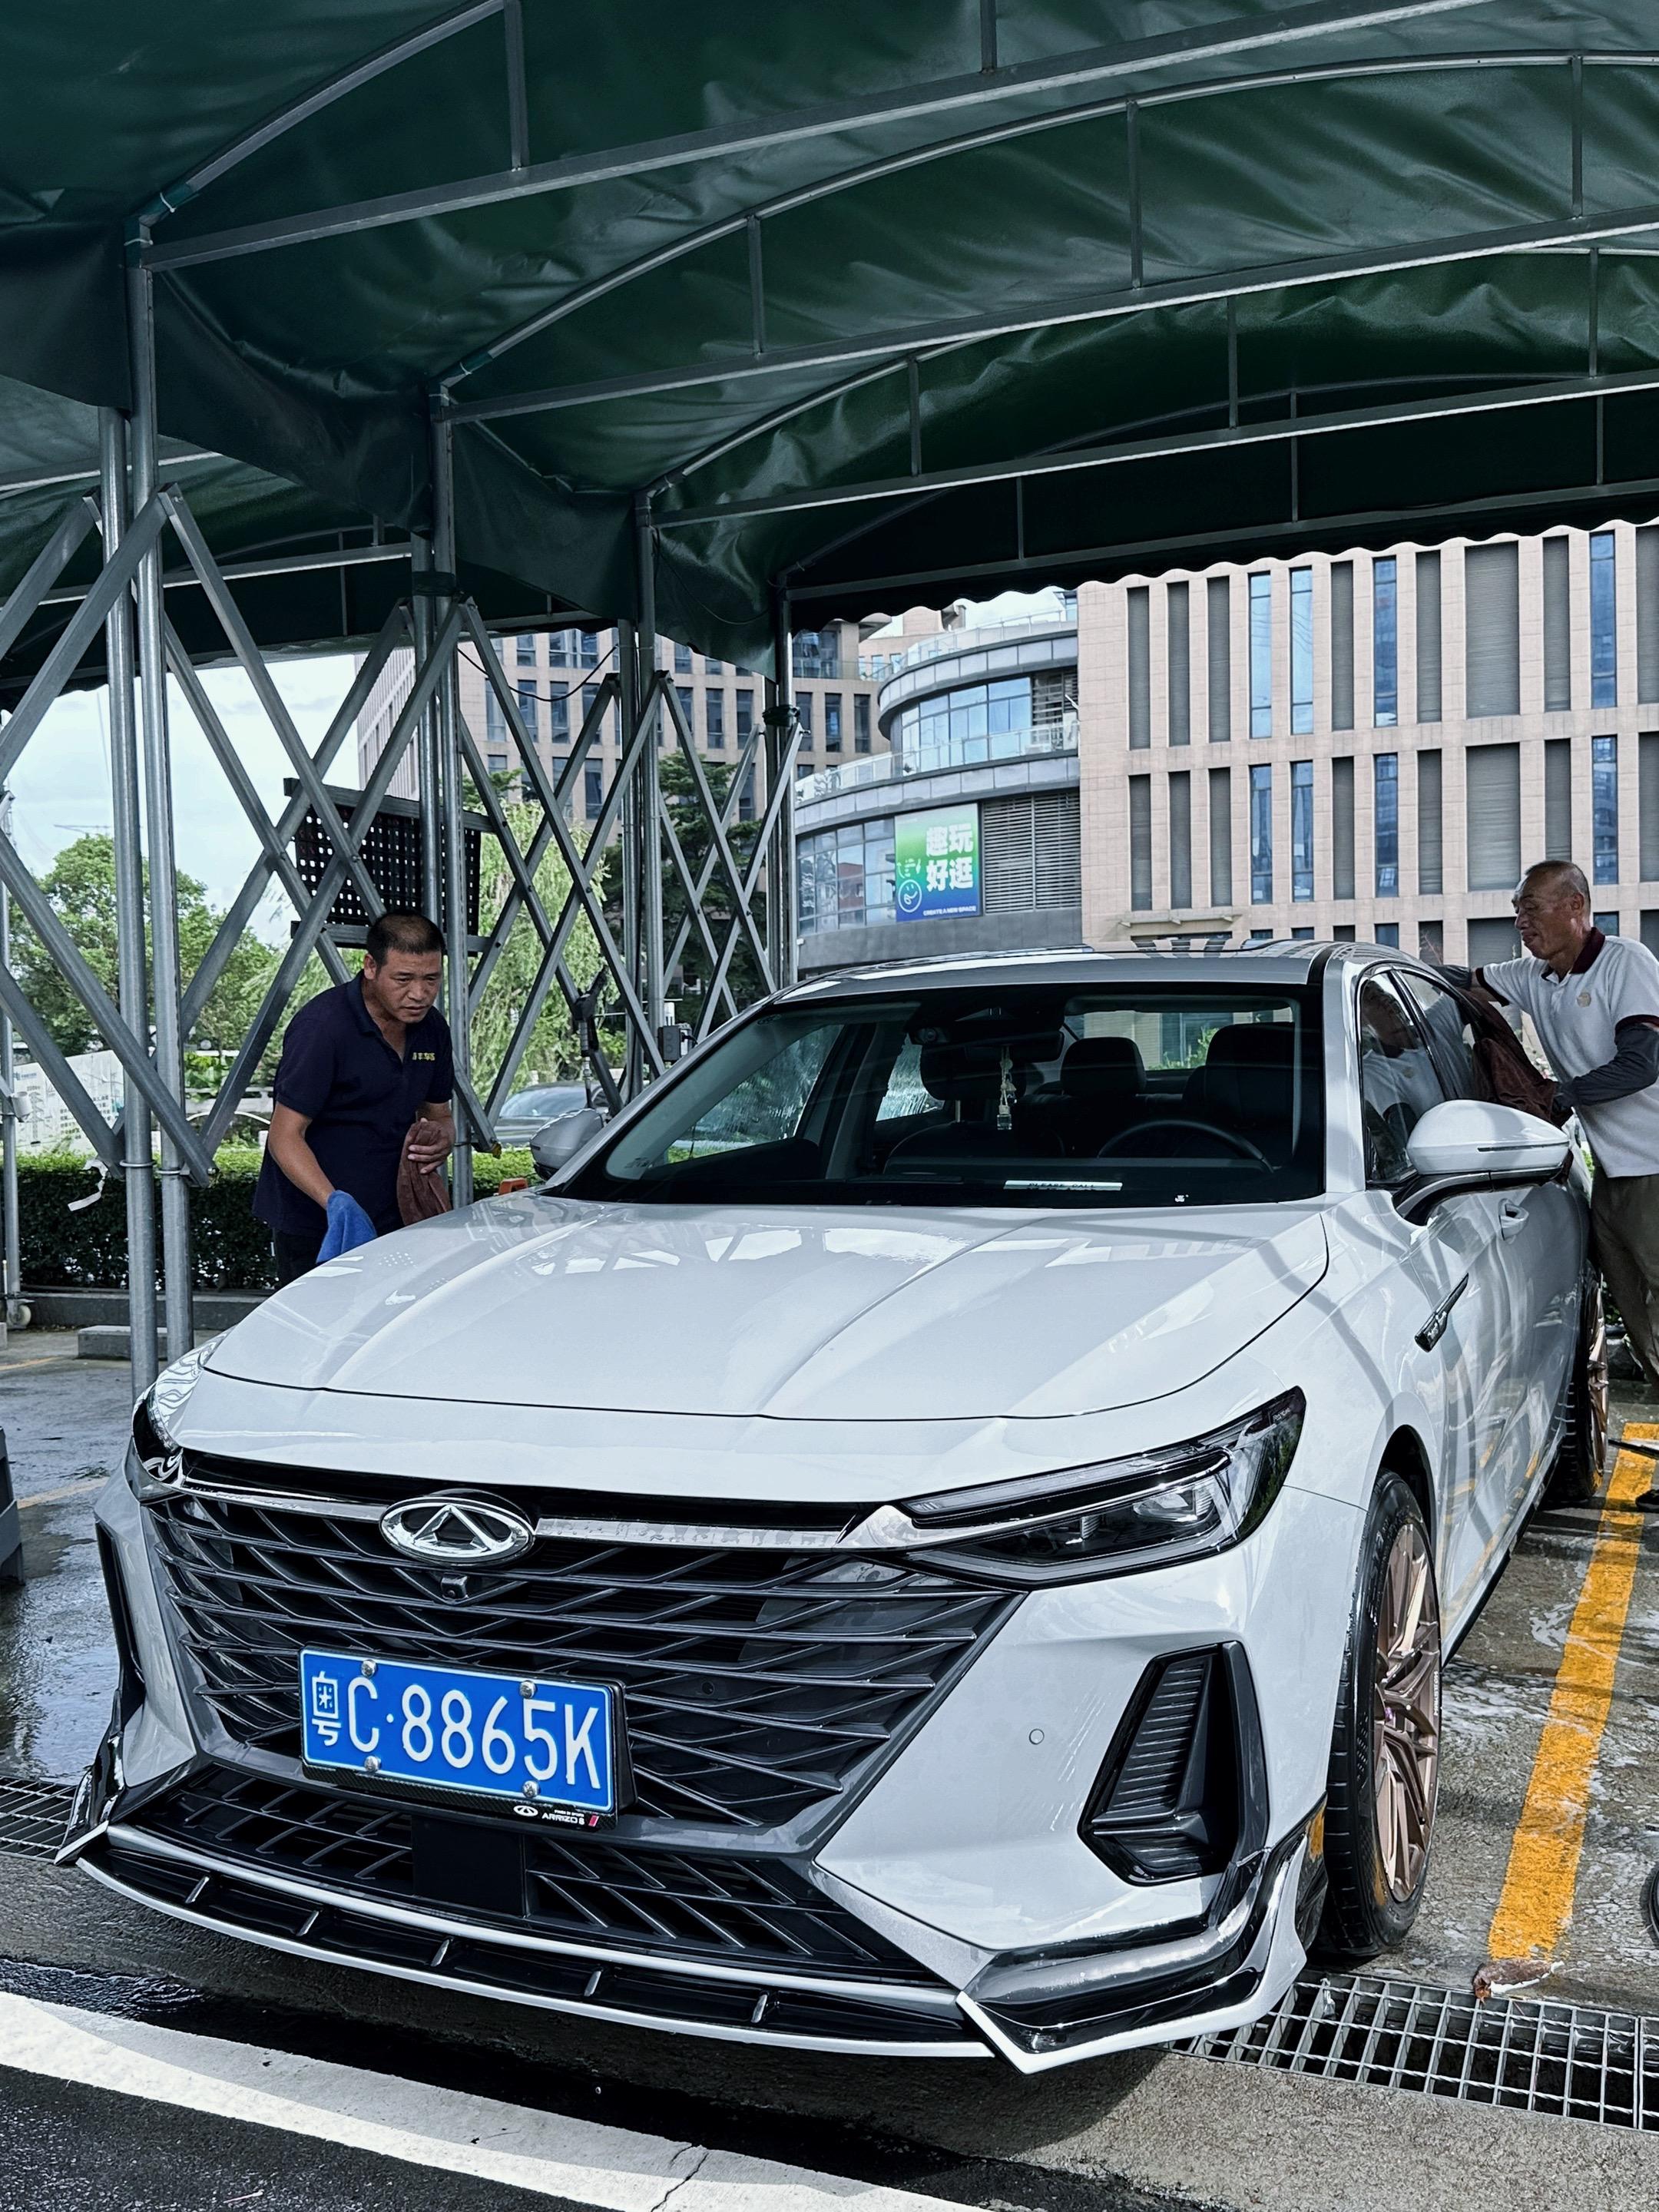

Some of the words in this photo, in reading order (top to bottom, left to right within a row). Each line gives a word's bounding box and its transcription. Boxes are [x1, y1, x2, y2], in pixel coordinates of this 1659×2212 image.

[926, 823, 974, 857] 趣玩
[926, 856, 974, 892] 好逛
[541, 1812, 578, 1824] ARRIZO
